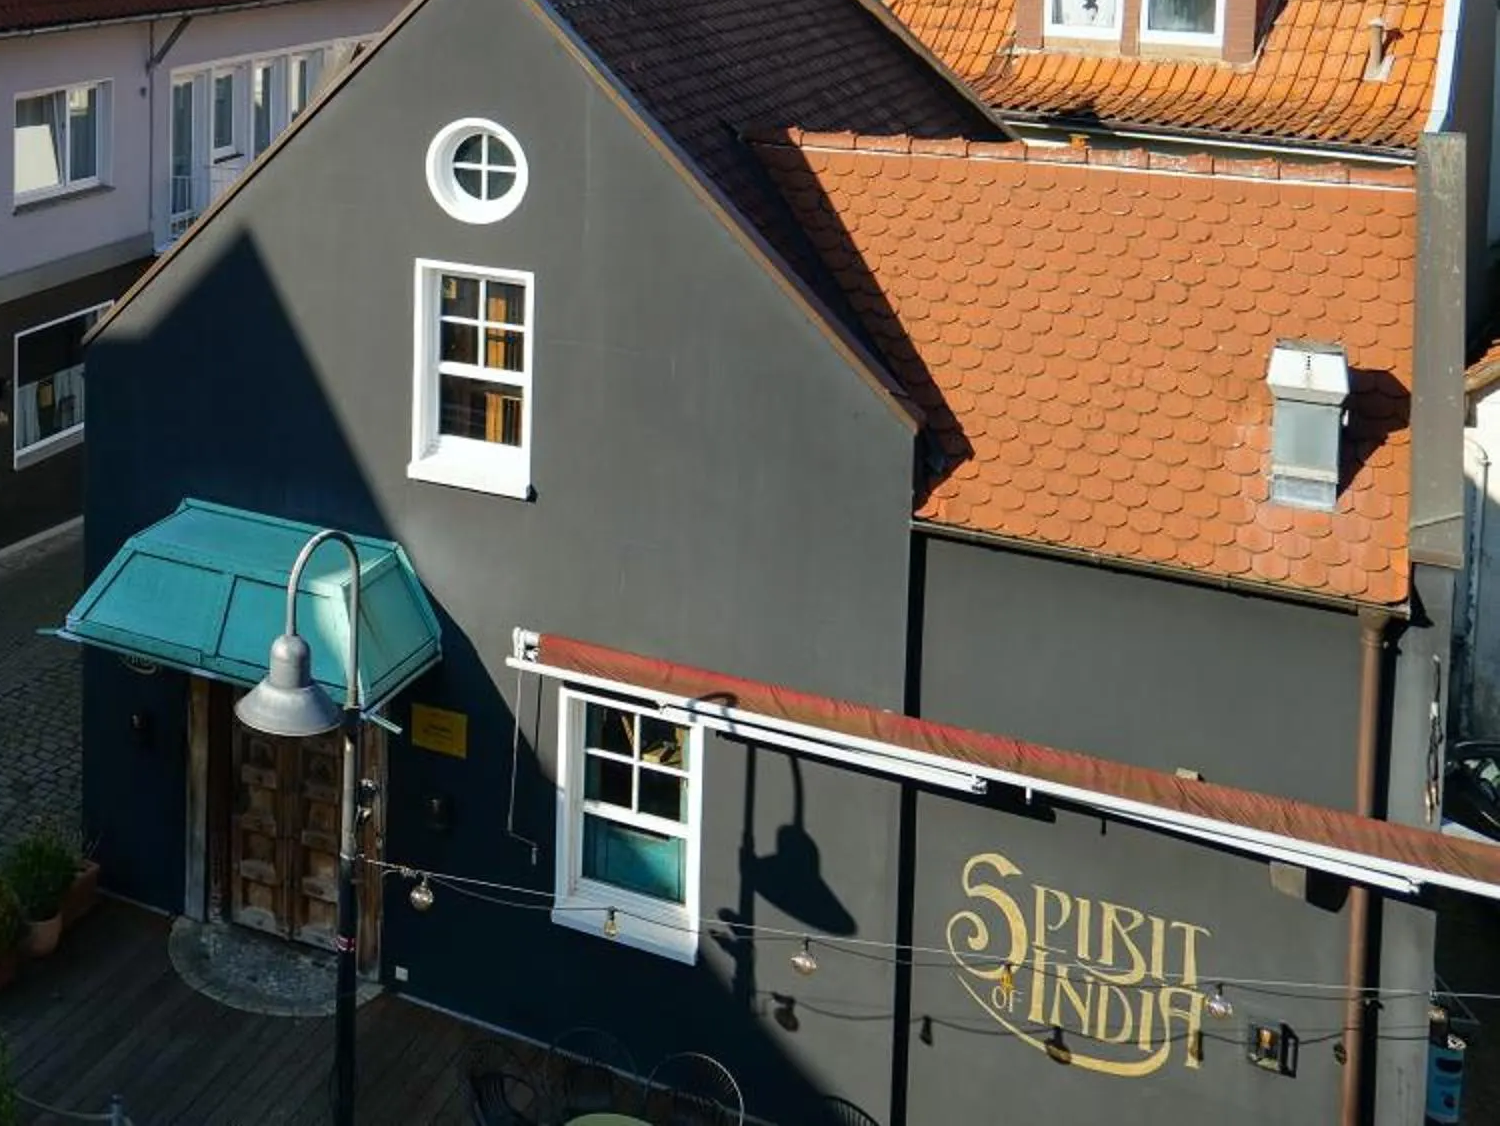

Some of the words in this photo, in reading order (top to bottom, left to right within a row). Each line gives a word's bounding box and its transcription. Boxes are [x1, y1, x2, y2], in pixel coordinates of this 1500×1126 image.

[946, 853, 1211, 985] SPIRIT
[991, 986, 1024, 1013] OF
[1027, 942, 1205, 1077] INDIA
